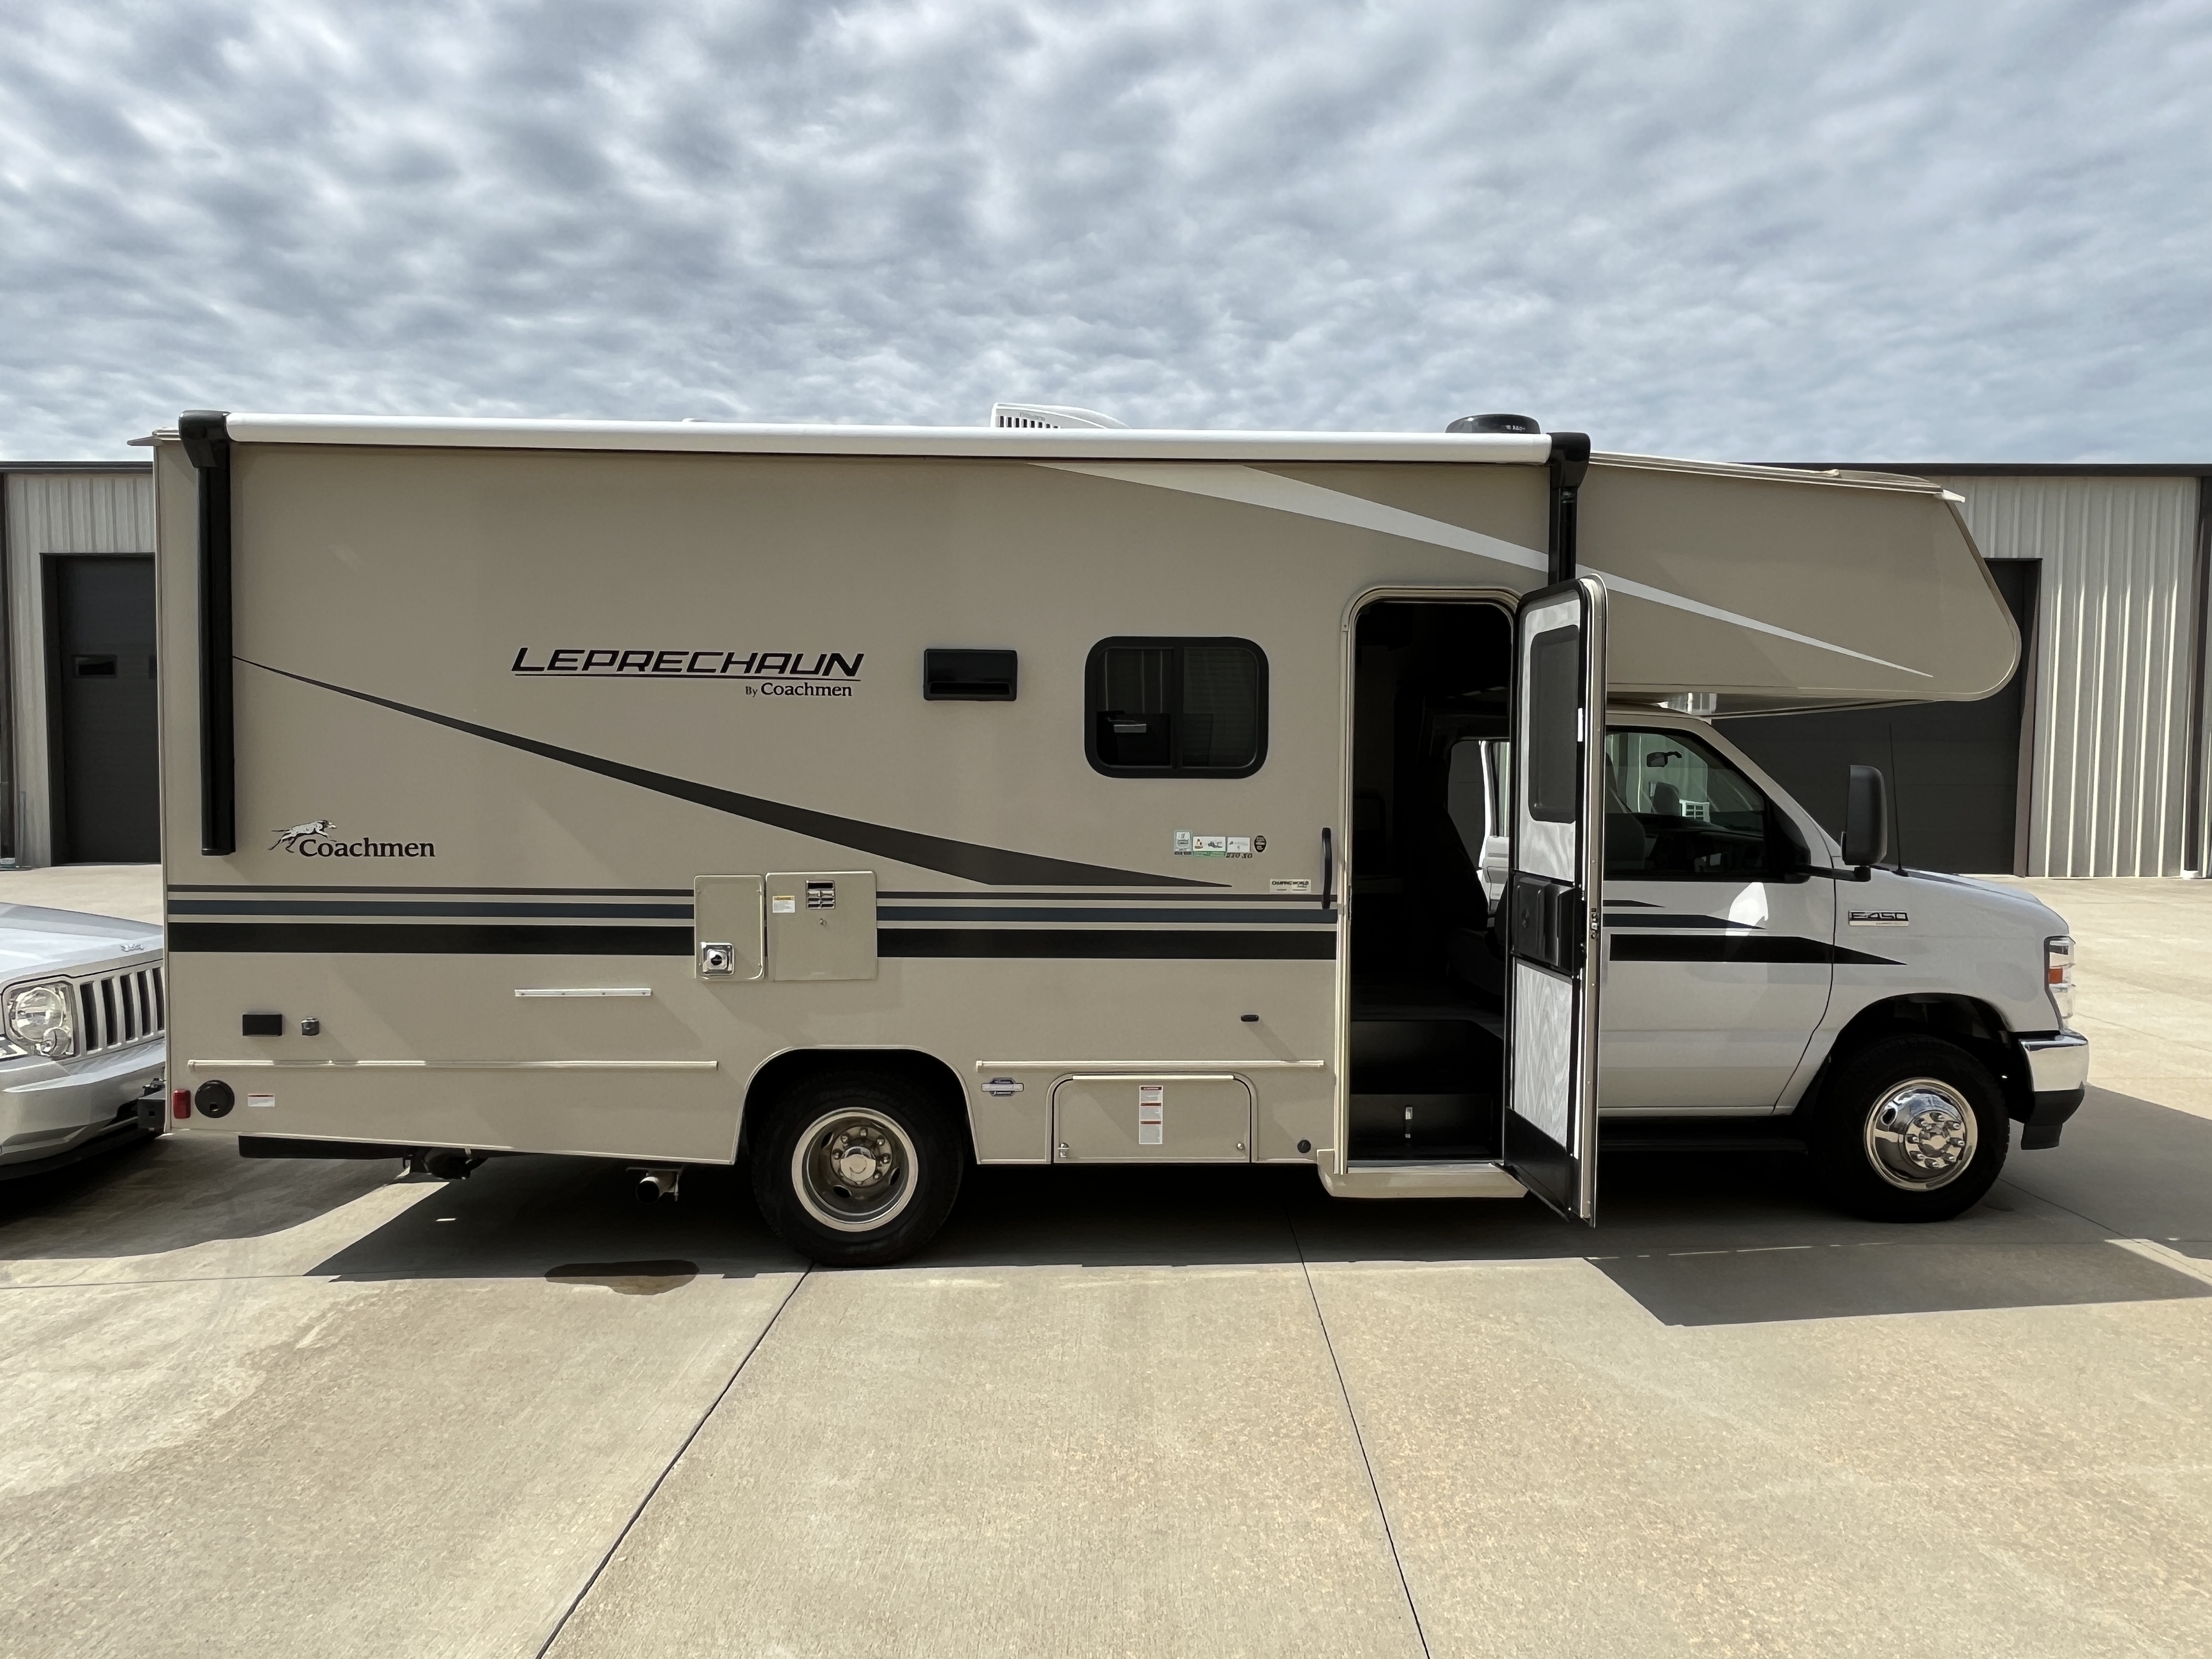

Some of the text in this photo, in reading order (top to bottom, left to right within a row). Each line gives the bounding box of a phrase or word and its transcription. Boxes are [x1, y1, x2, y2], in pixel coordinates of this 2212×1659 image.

[511, 647, 865, 677] LEPRECHAUN
[745, 682, 852, 697] By Coachmen
[299, 837, 436, 857] Coachmen
